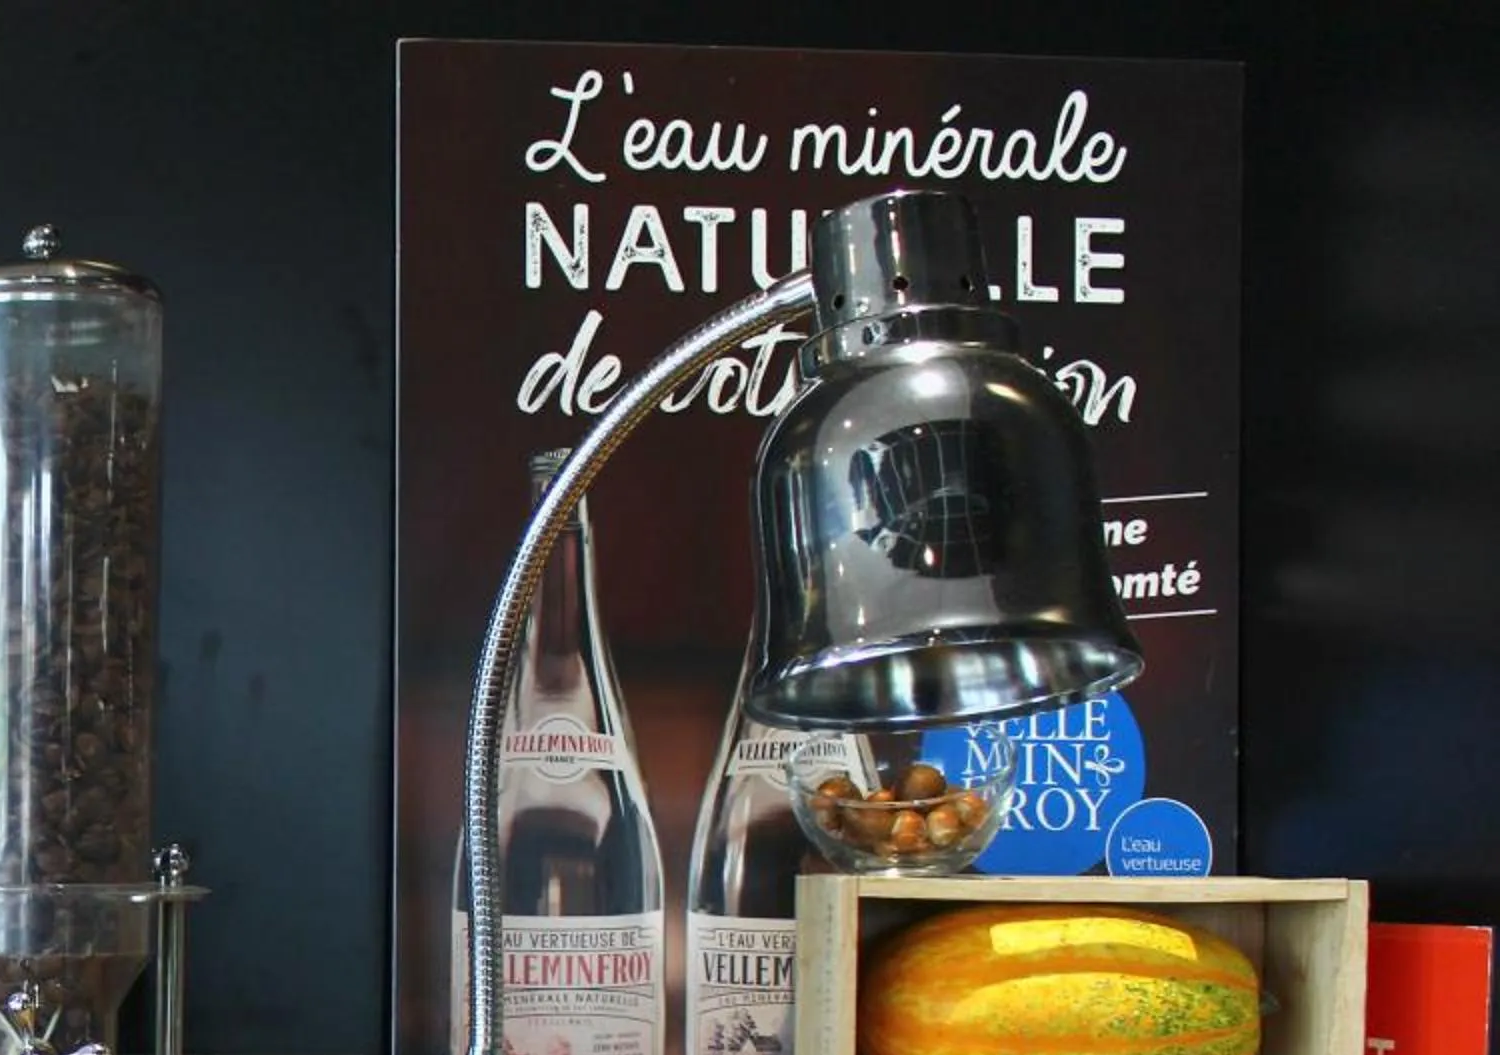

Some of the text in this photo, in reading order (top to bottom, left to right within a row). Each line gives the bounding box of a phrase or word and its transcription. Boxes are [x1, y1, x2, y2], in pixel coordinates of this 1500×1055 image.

[525, 69, 1127, 182] L'eau minérale
[524, 202, 1125, 304] NATULE
[516, 309, 628, 416] de
[962, 776, 1111, 831] ROY
[1121, 836, 1161, 853] L'eau
[1121, 855, 1202, 872] vertueuse
[529, 932, 614, 949] VERTUEUSE
